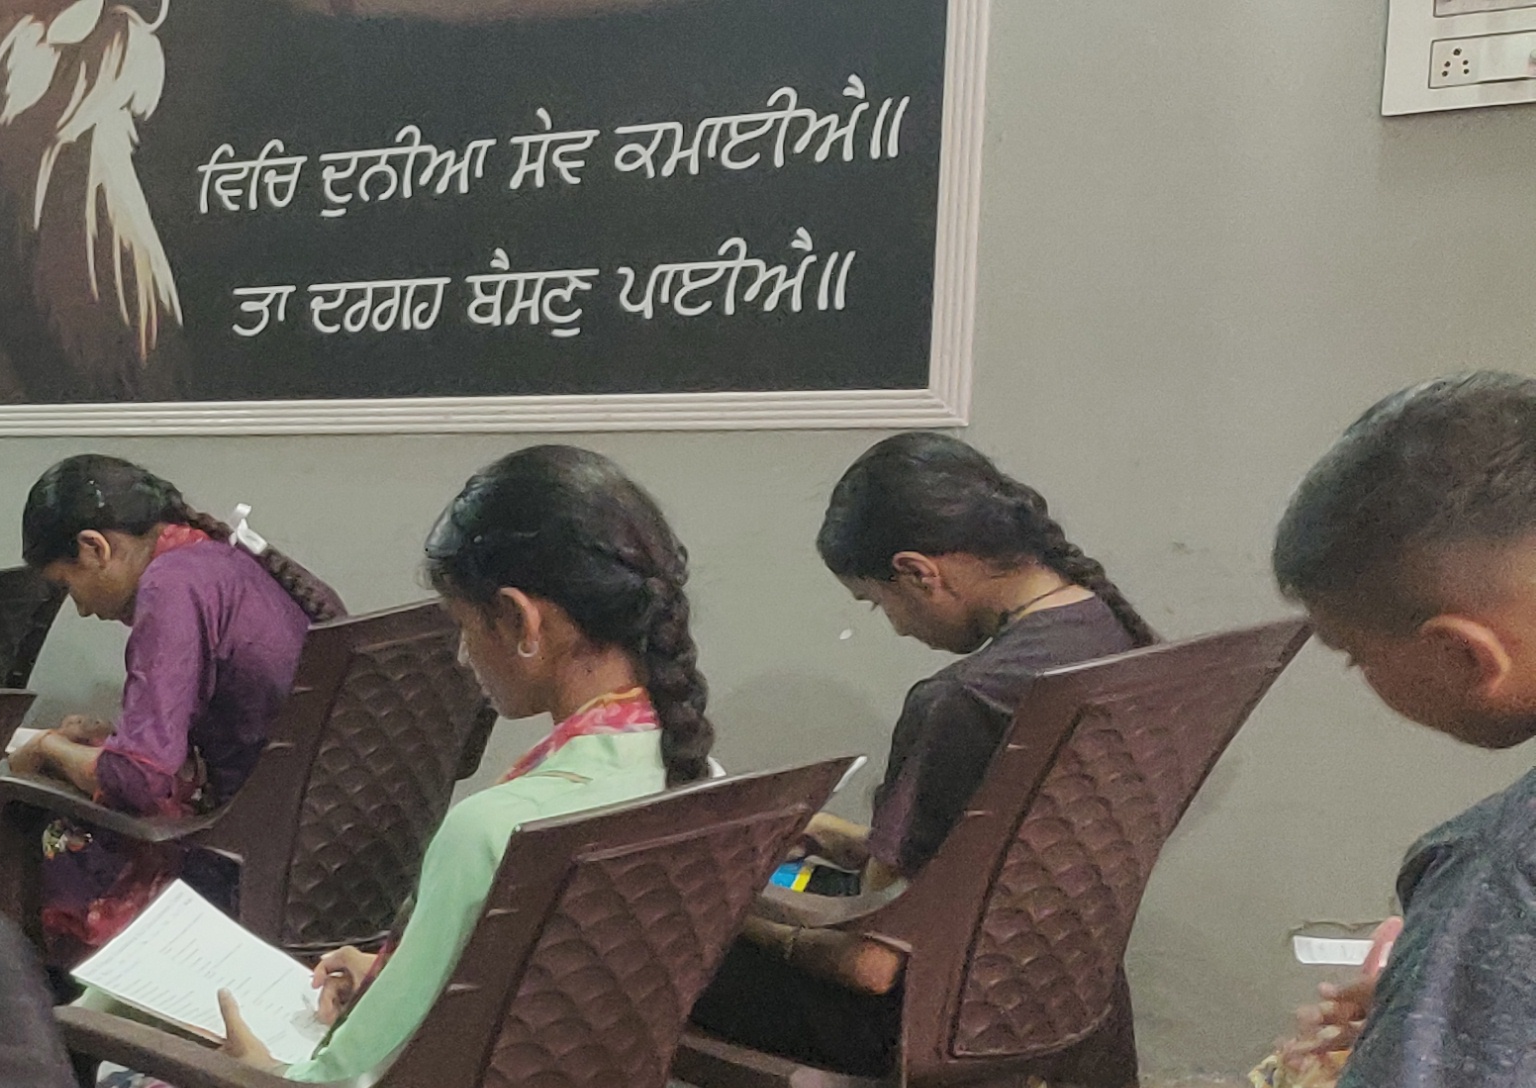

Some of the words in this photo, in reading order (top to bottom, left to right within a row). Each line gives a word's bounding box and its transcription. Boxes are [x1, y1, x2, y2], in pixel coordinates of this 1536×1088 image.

[197, 138, 308, 214] ਵਿਚਿ
[319, 124, 497, 218] ਦੁਨੀਆ
[509, 107, 603, 190] ਸੇਵ
[231, 285, 297, 337] ਤਾ
[307, 276, 452, 334] ਦਰਗਹ
[464, 247, 601, 338] ਬੈਸਣੁ
